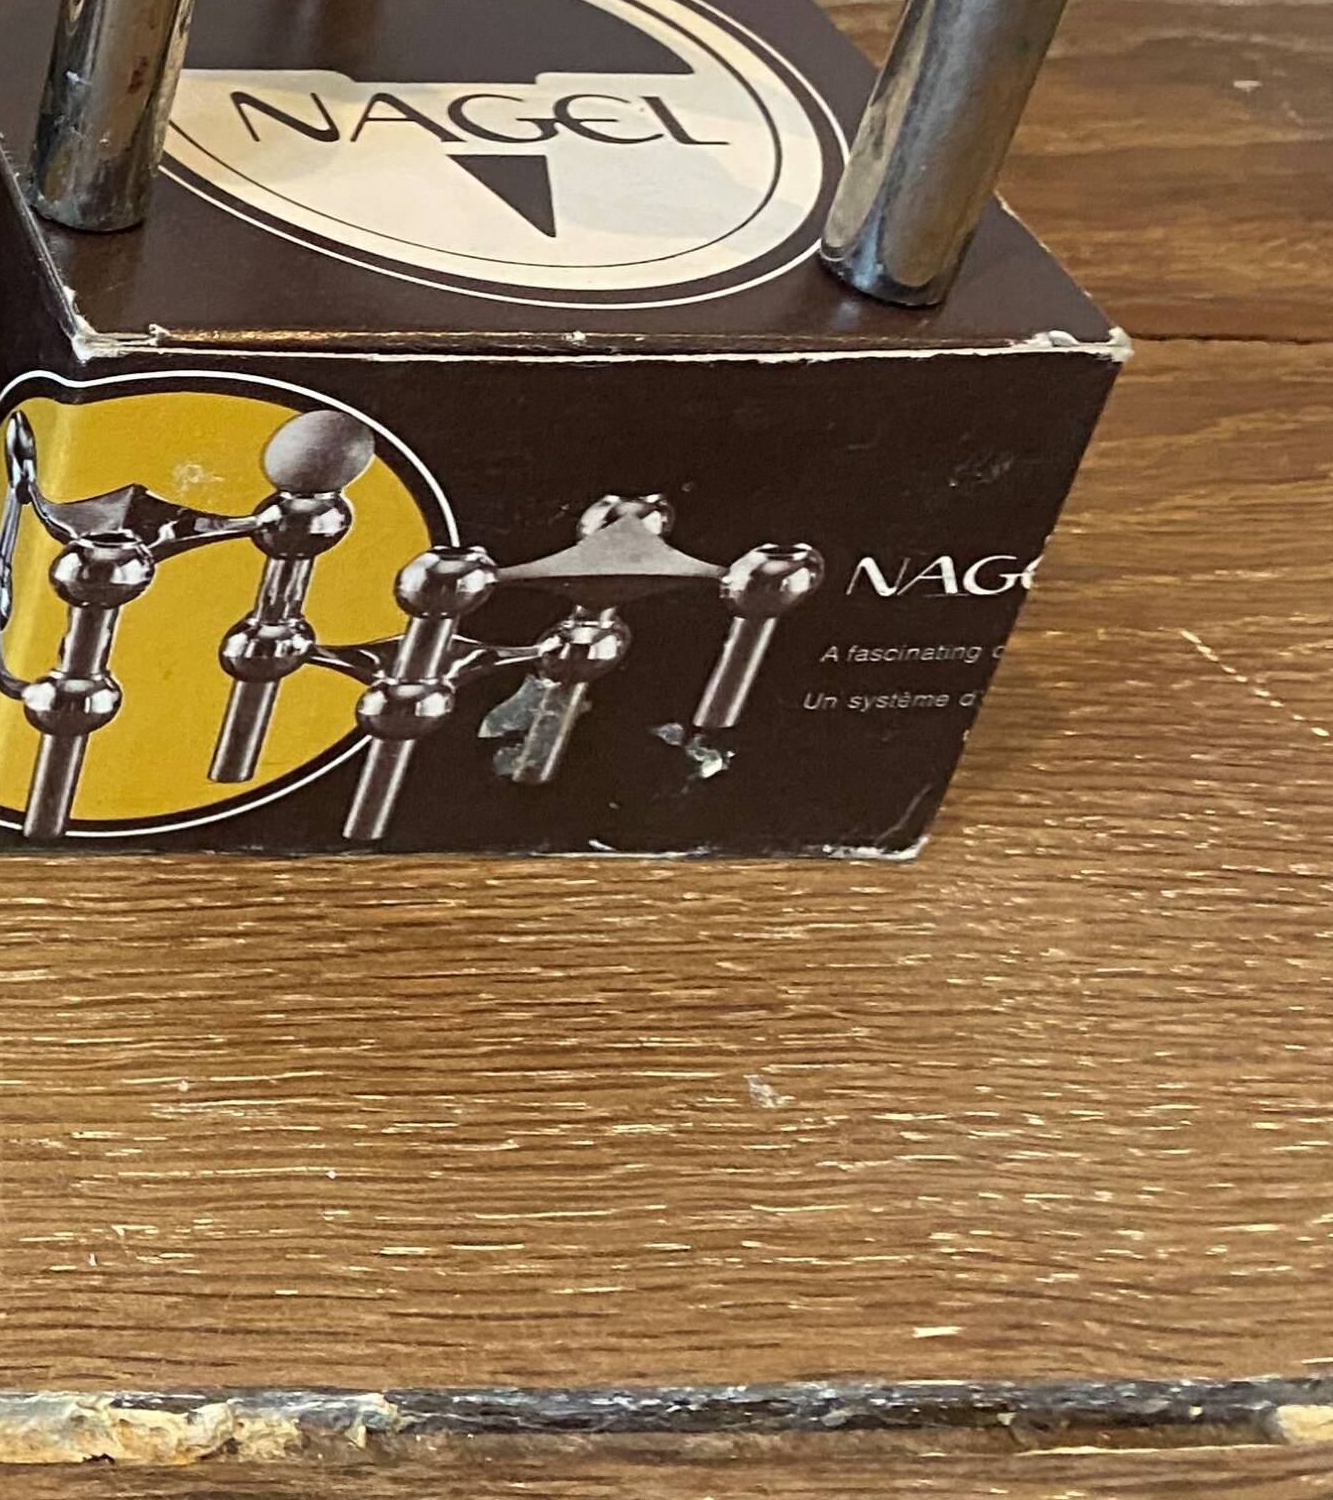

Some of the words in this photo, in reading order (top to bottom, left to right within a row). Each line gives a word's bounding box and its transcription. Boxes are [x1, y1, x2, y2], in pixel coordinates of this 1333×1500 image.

[230, 92, 730, 146] NAGEL
[820, 646, 839, 663] A
[846, 644, 983, 664] fascinating
[803, 692, 838, 711] Un
